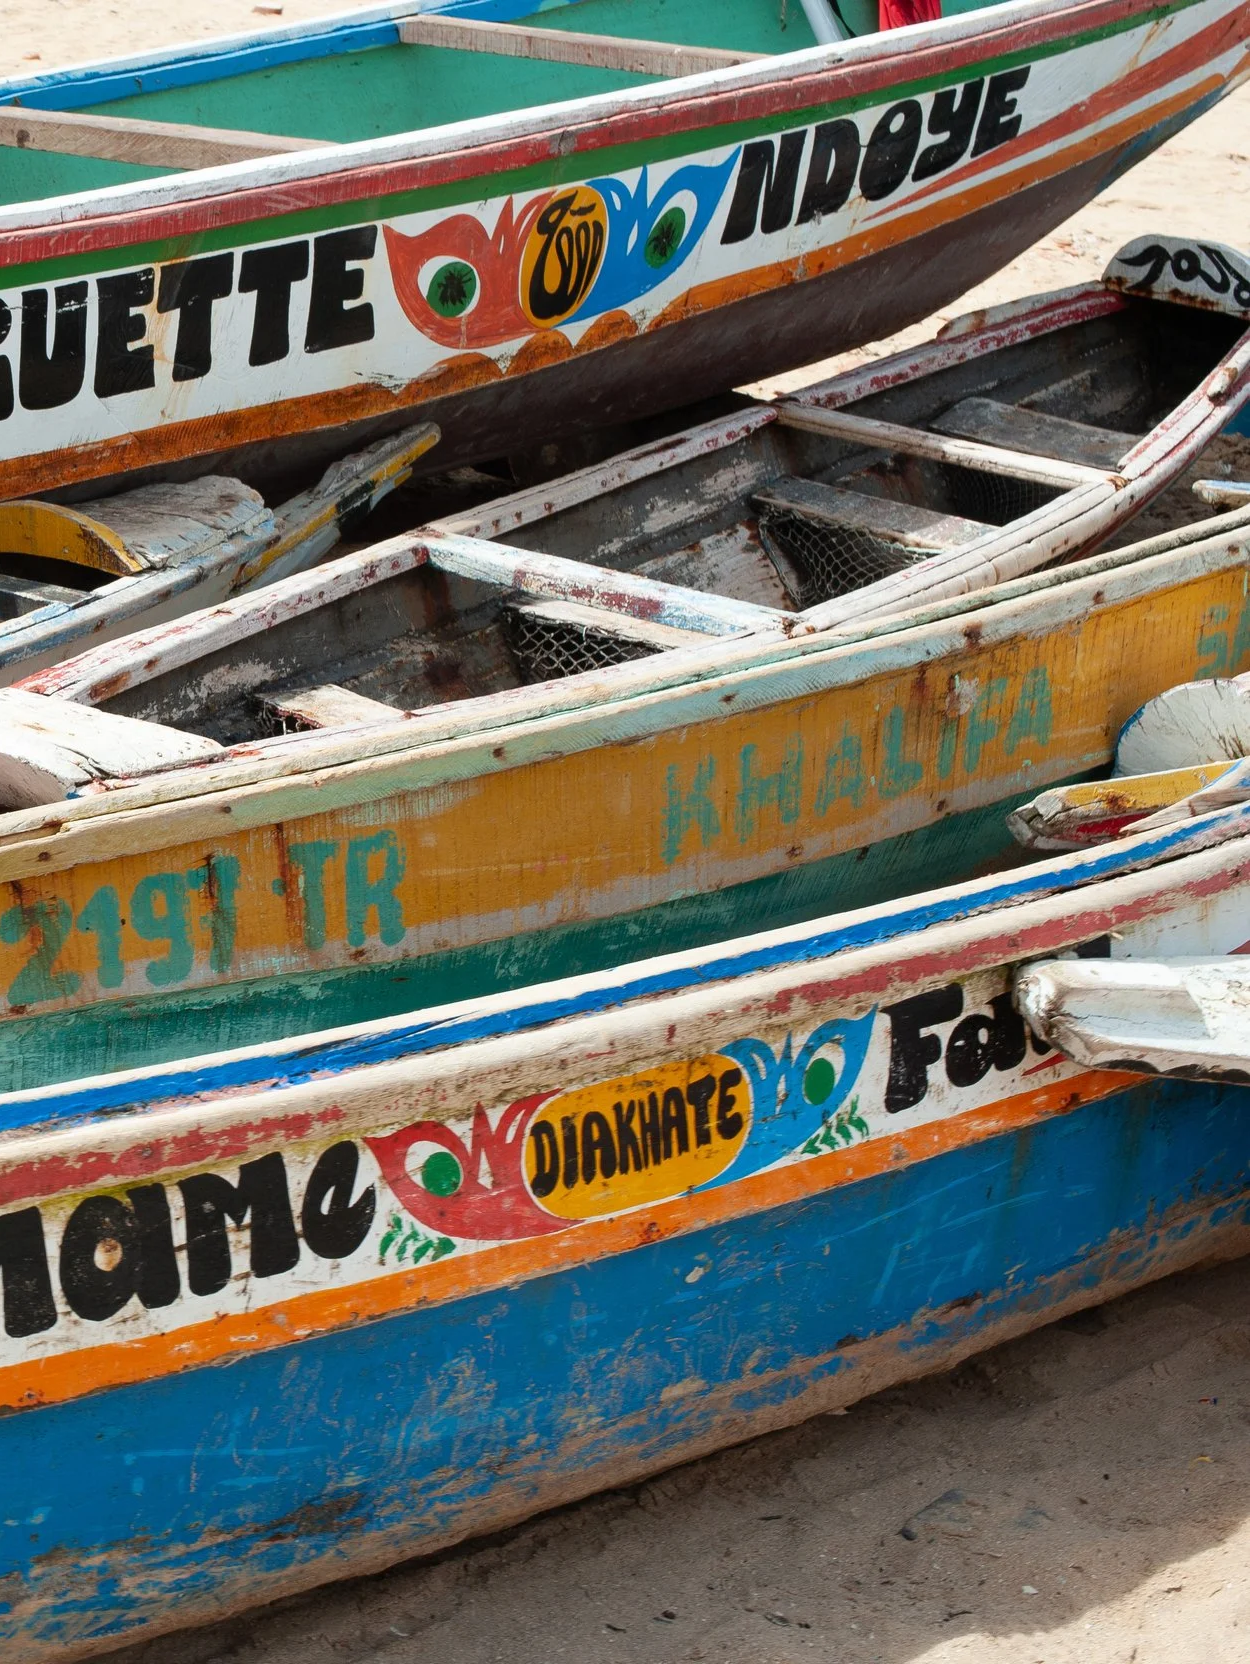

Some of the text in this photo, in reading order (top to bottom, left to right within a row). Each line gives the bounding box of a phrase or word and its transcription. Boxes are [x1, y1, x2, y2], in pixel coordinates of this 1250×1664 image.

[720, 65, 1032, 245] NDOYE
[661, 665, 1053, 864] KHALIFA
[289, 829, 407, 949] TR
[530, 1067, 744, 1198] DIAKHATE
